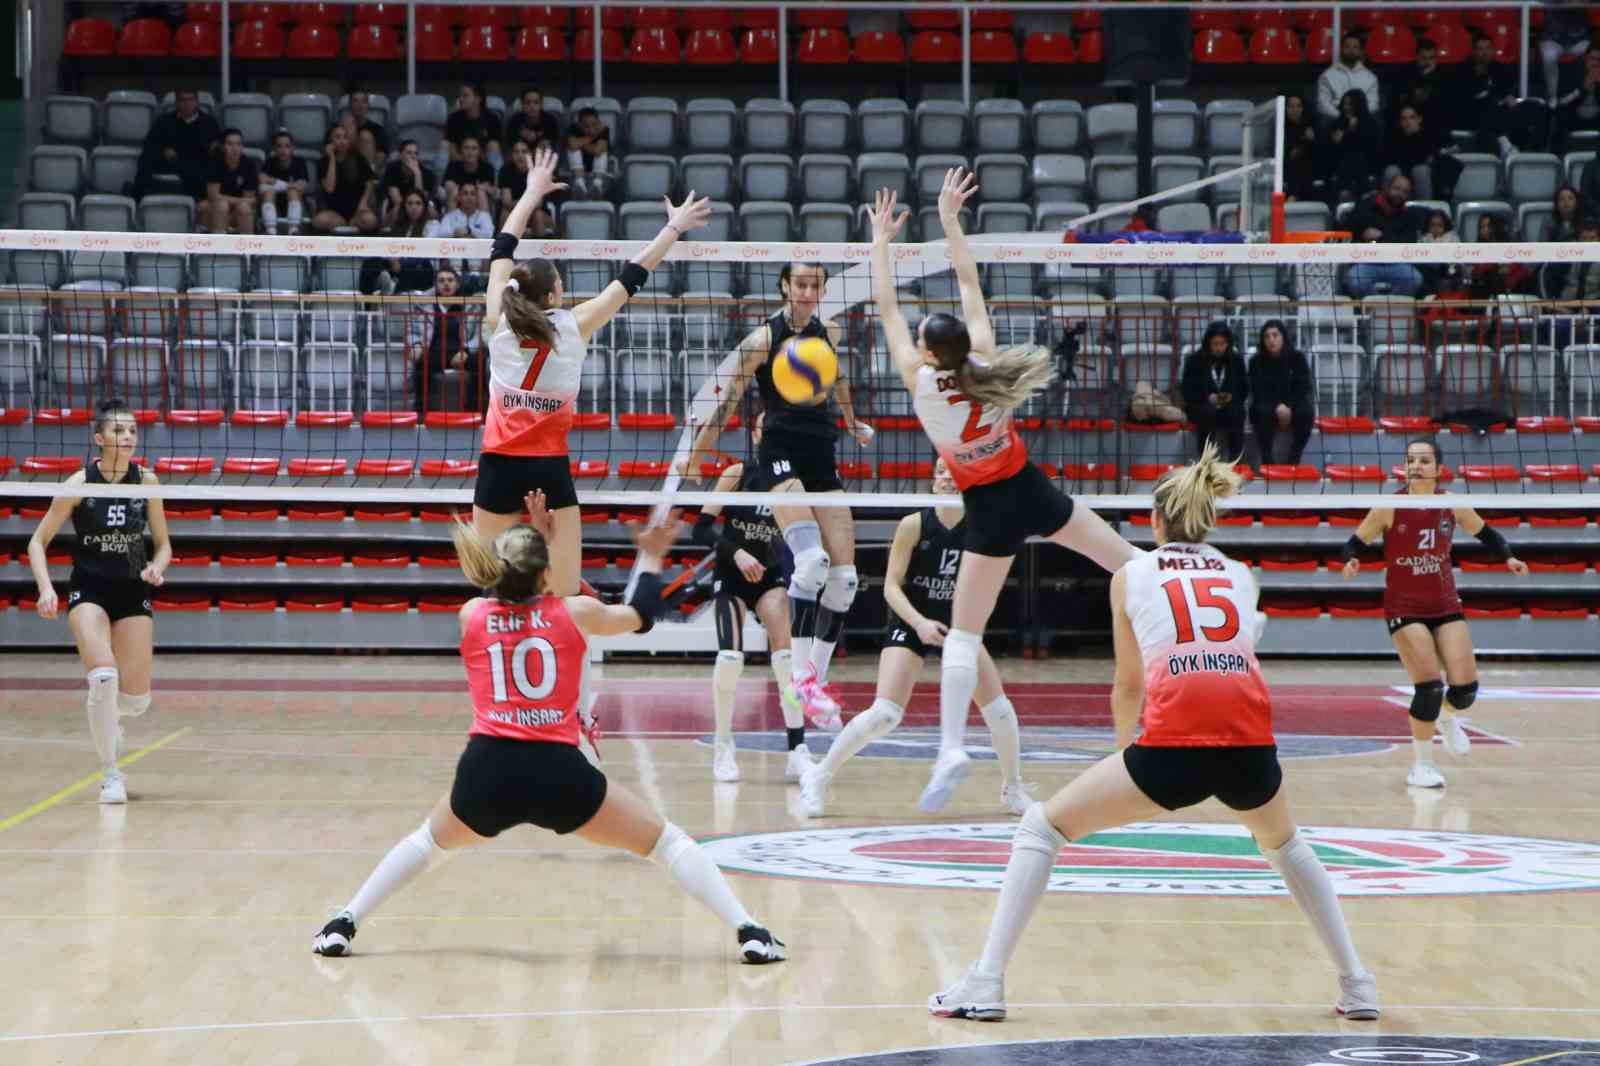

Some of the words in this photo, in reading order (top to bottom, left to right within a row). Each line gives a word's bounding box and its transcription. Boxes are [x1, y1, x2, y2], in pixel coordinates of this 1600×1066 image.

[520, 337, 553, 391] 7
[503, 391, 522, 408] ÖYK
[947, 393, 992, 443] 2
[106, 504, 127, 527] 55
[731, 518, 784, 536] CADENC
[1418, 528, 1436, 550] 21
[940, 548, 961, 574] 12
[486, 611, 525, 634] ELİF
[531, 608, 552, 629] K.
[1160, 577, 1241, 645] 15
[891, 628, 908, 642] 12
[486, 635, 558, 704] 10
[1168, 654, 1200, 677] ÖYK
